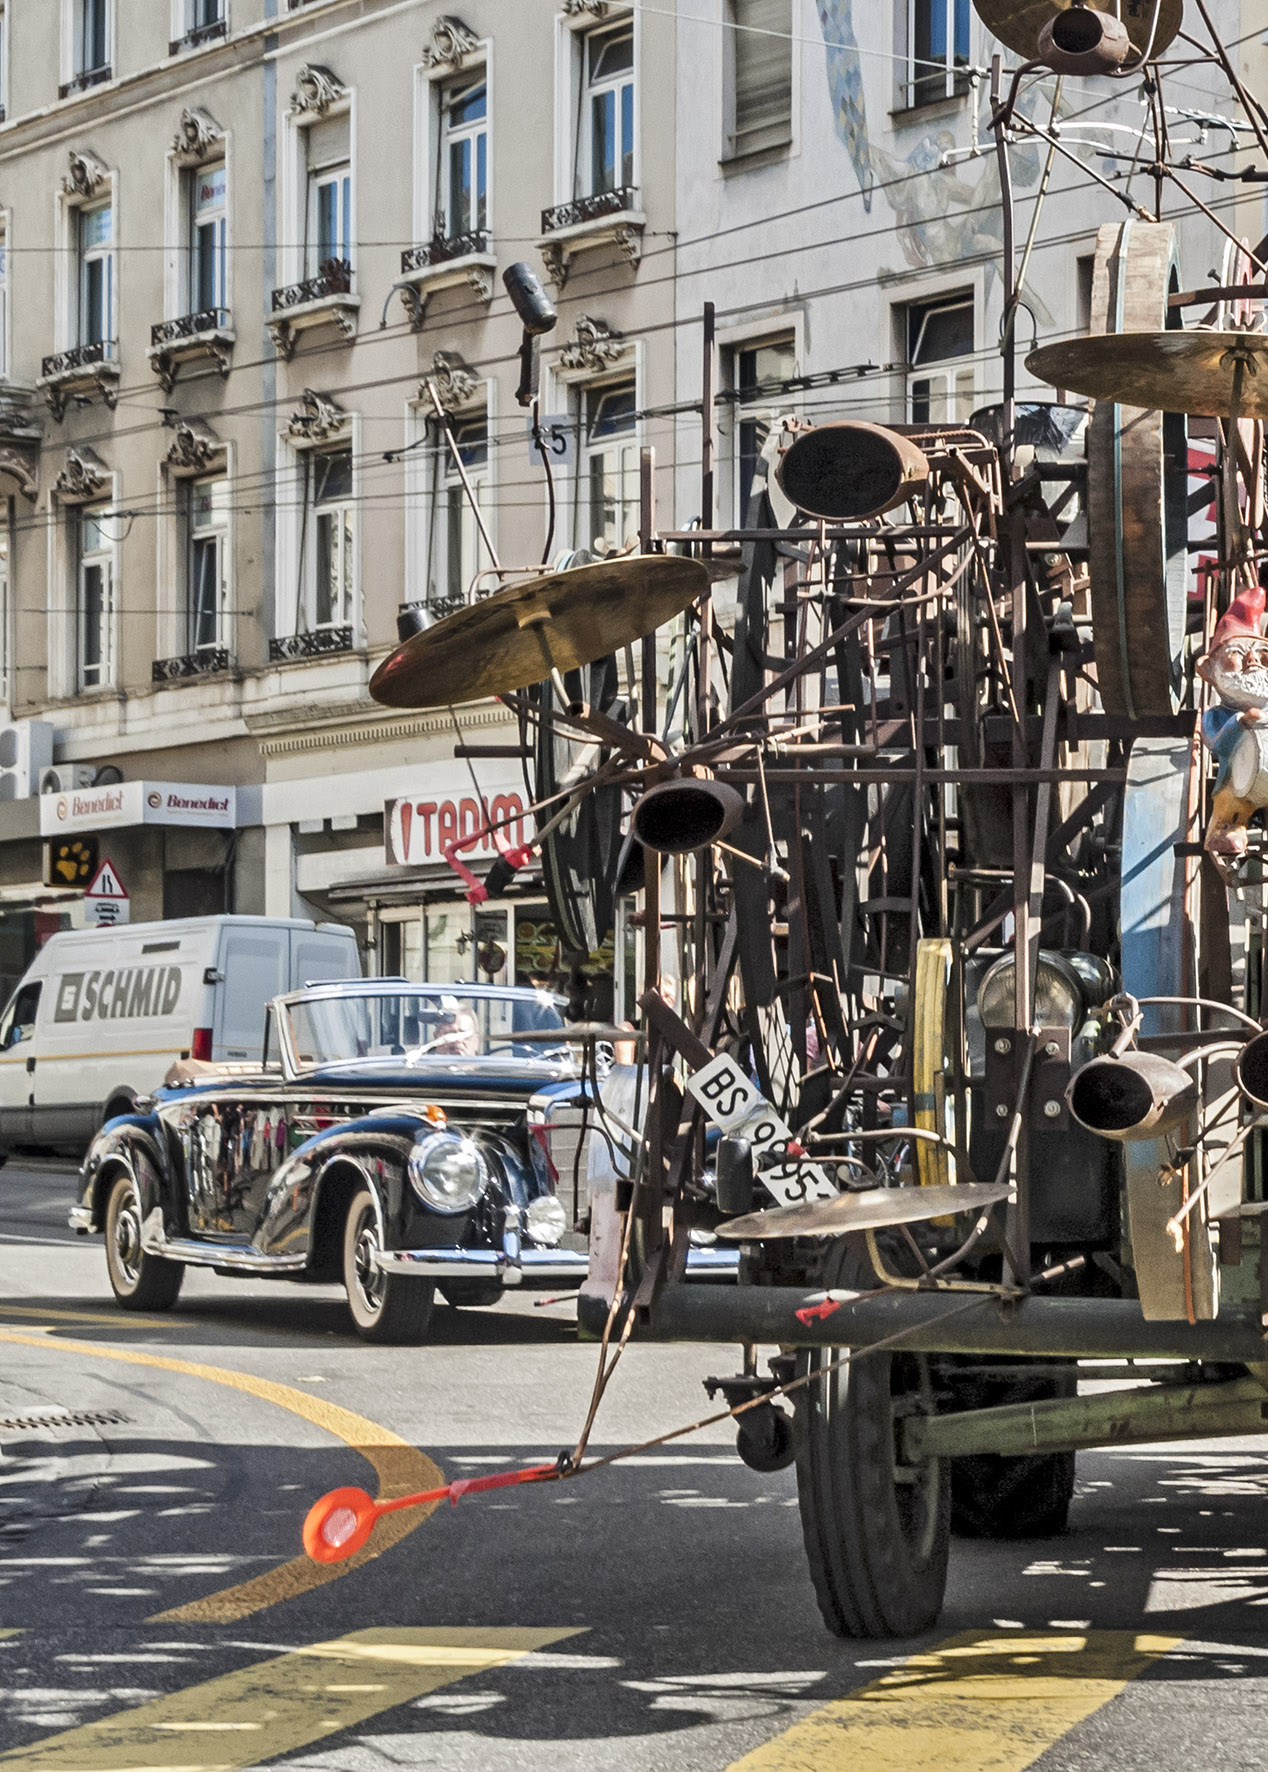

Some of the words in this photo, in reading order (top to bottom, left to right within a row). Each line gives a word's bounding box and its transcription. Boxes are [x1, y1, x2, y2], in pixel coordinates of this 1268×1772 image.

[72, 790, 124, 816] Benedict
[167, 794, 229, 812] Benedict
[81, 966, 182, 1021] SCHMID
[700, 1066, 749, 1116] BS
